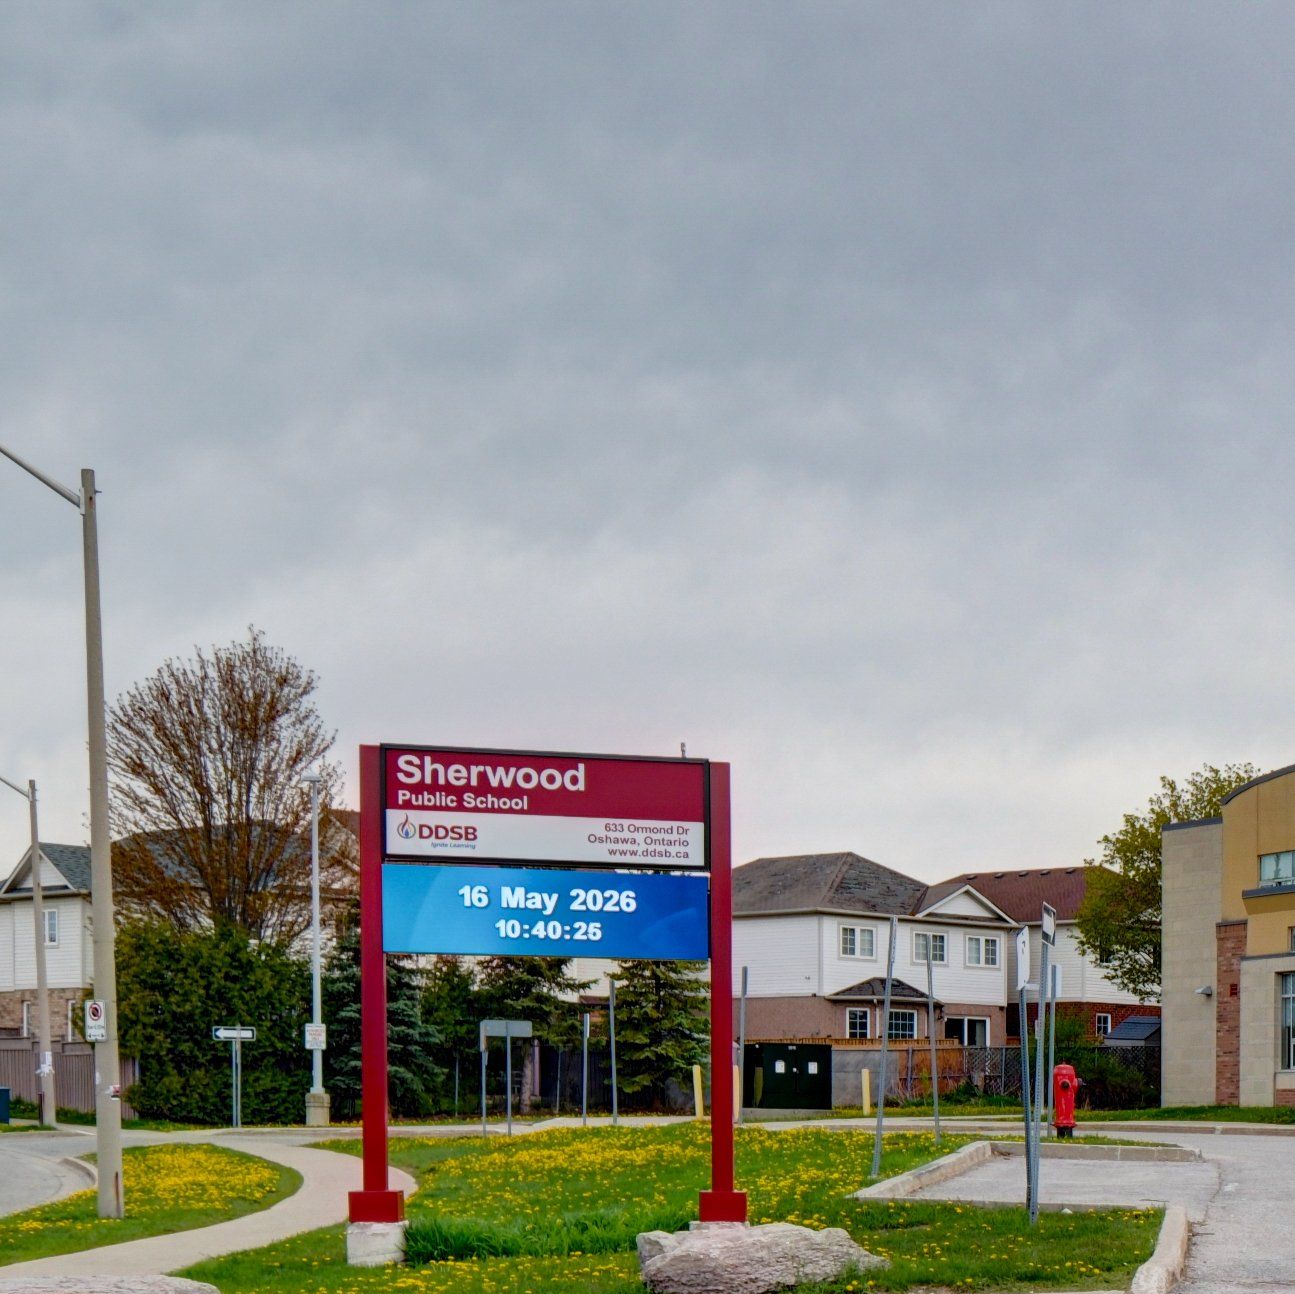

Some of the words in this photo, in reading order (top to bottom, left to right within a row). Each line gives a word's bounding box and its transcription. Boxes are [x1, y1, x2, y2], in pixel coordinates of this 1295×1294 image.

[397, 754, 585, 791] Sherwood
[397, 790, 457, 807] Public
[463, 792, 528, 810] School
[418, 823, 478, 841] DDSB
[604, 822, 625, 833] 633
[627, 823, 674, 836] Ormond
[676, 825, 690, 836] Dr
[430, 841, 449, 849] Ignite
[449, 841, 476, 850] Learning
[587, 833, 640, 846] Oshawa,
[643, 835, 690, 848] Ontario
[607, 847, 690, 860] www.ddsb.ca
[458, 885, 489, 908] 16
[500, 886, 559, 915] May
[569, 888, 638, 912] 2026
